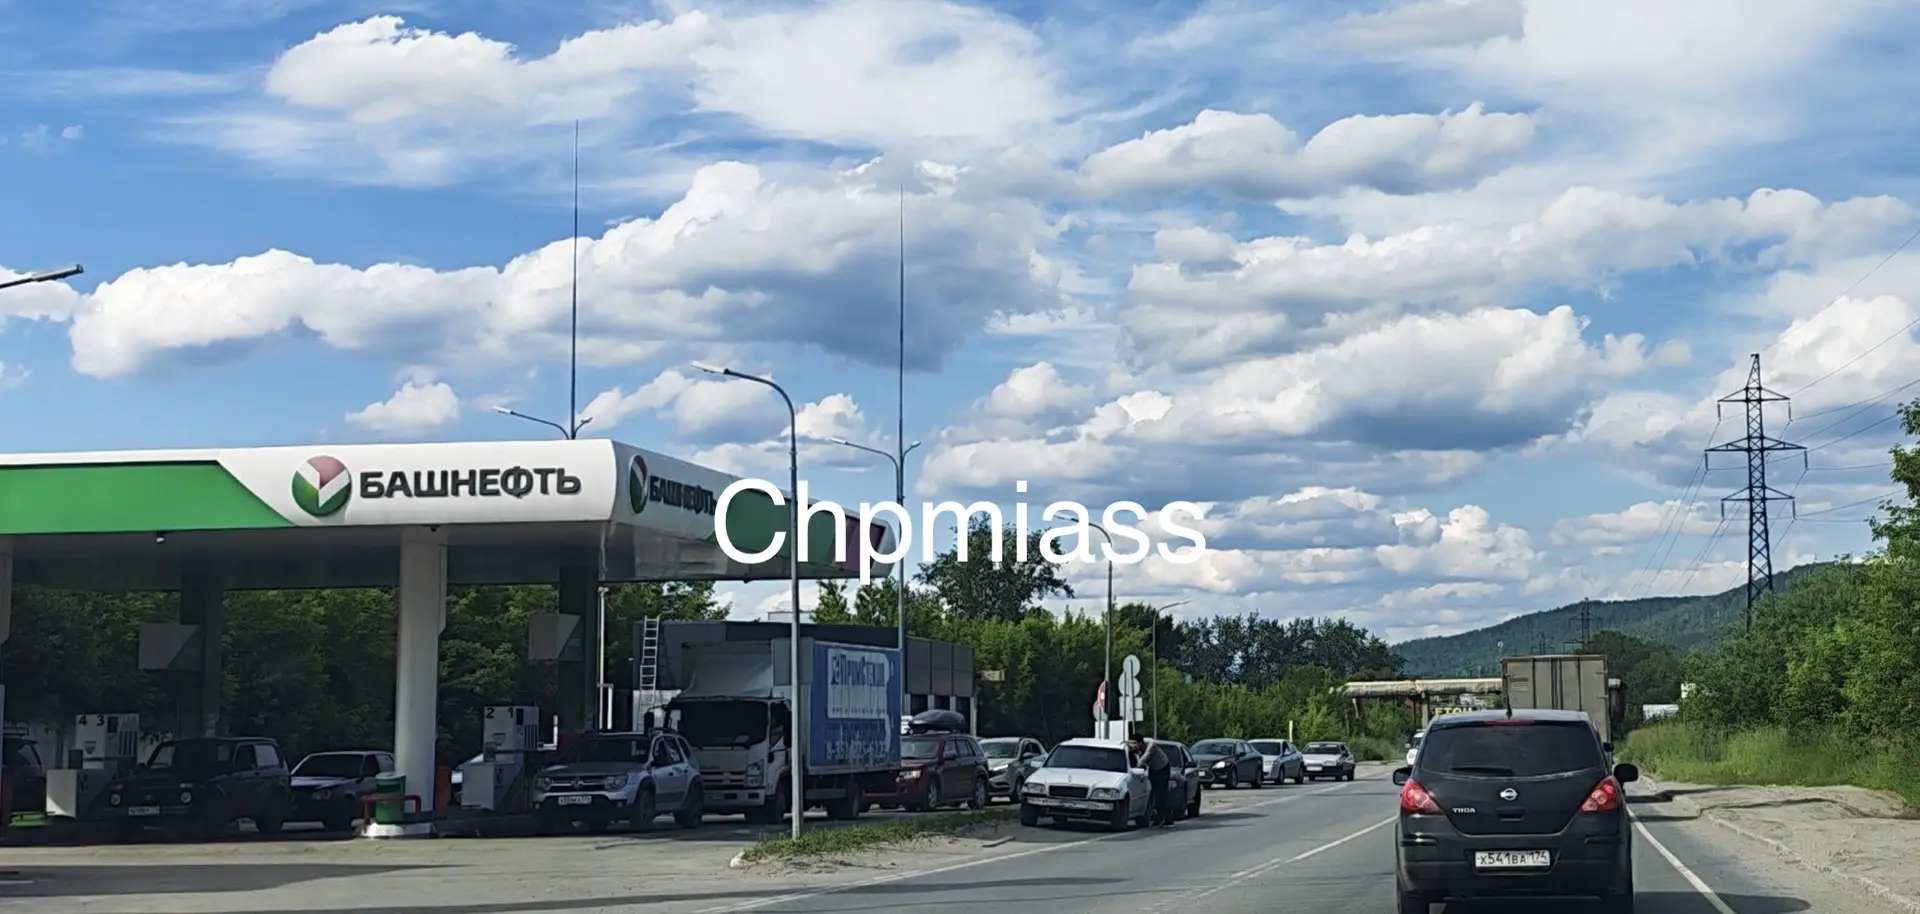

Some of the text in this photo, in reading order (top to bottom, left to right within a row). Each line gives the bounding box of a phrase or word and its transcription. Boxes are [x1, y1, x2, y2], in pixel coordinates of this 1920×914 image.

[360, 466, 582, 499] БАШНЕФТЬ
[486, 707, 513, 719] 2 1
[79, 714, 104, 727] 4 3
